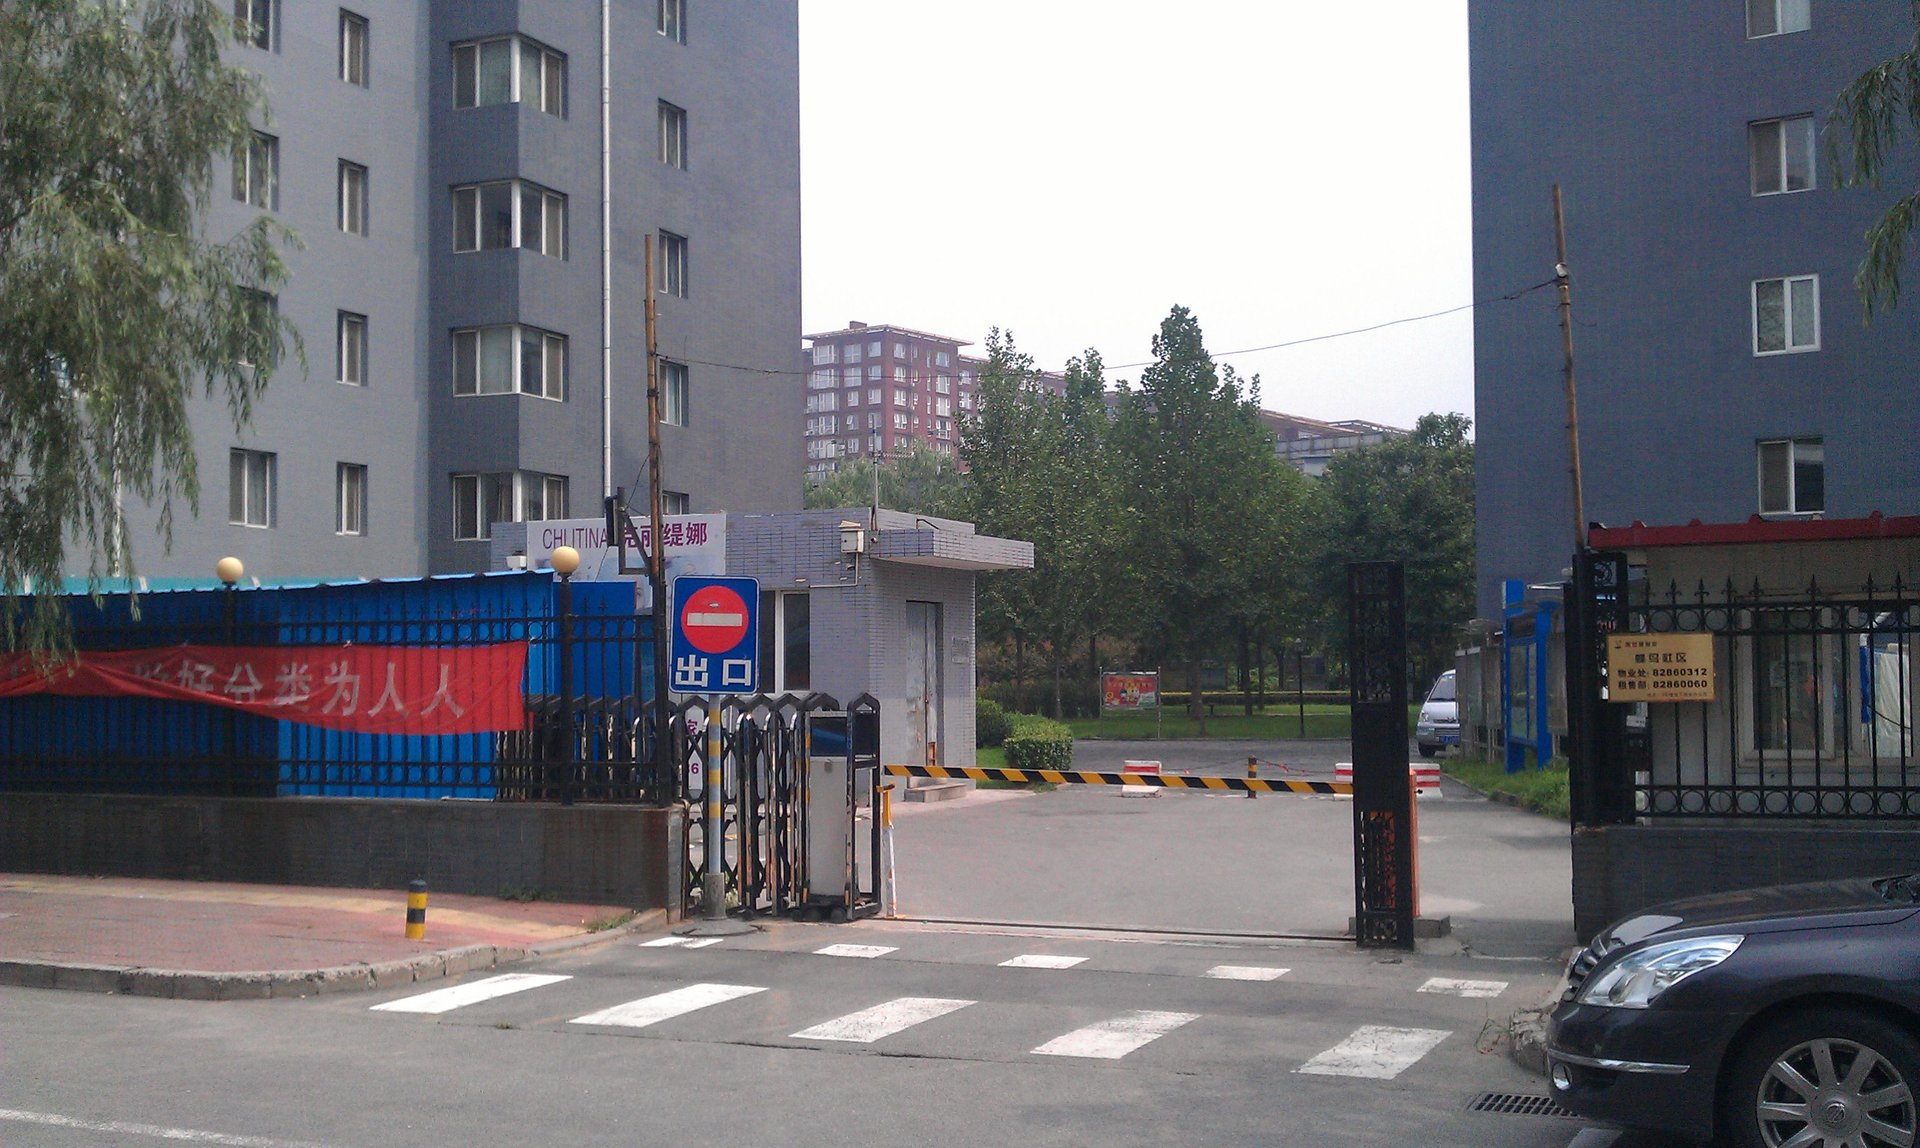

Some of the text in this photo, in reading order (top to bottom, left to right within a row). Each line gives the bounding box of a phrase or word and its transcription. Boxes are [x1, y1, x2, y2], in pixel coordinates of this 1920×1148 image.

[543, 527, 608, 549] CHLITINA
[675, 654, 752, 687] 出口
[1653, 668, 1707, 677] 82860312
[1653, 680, 1707, 689] 82860060
